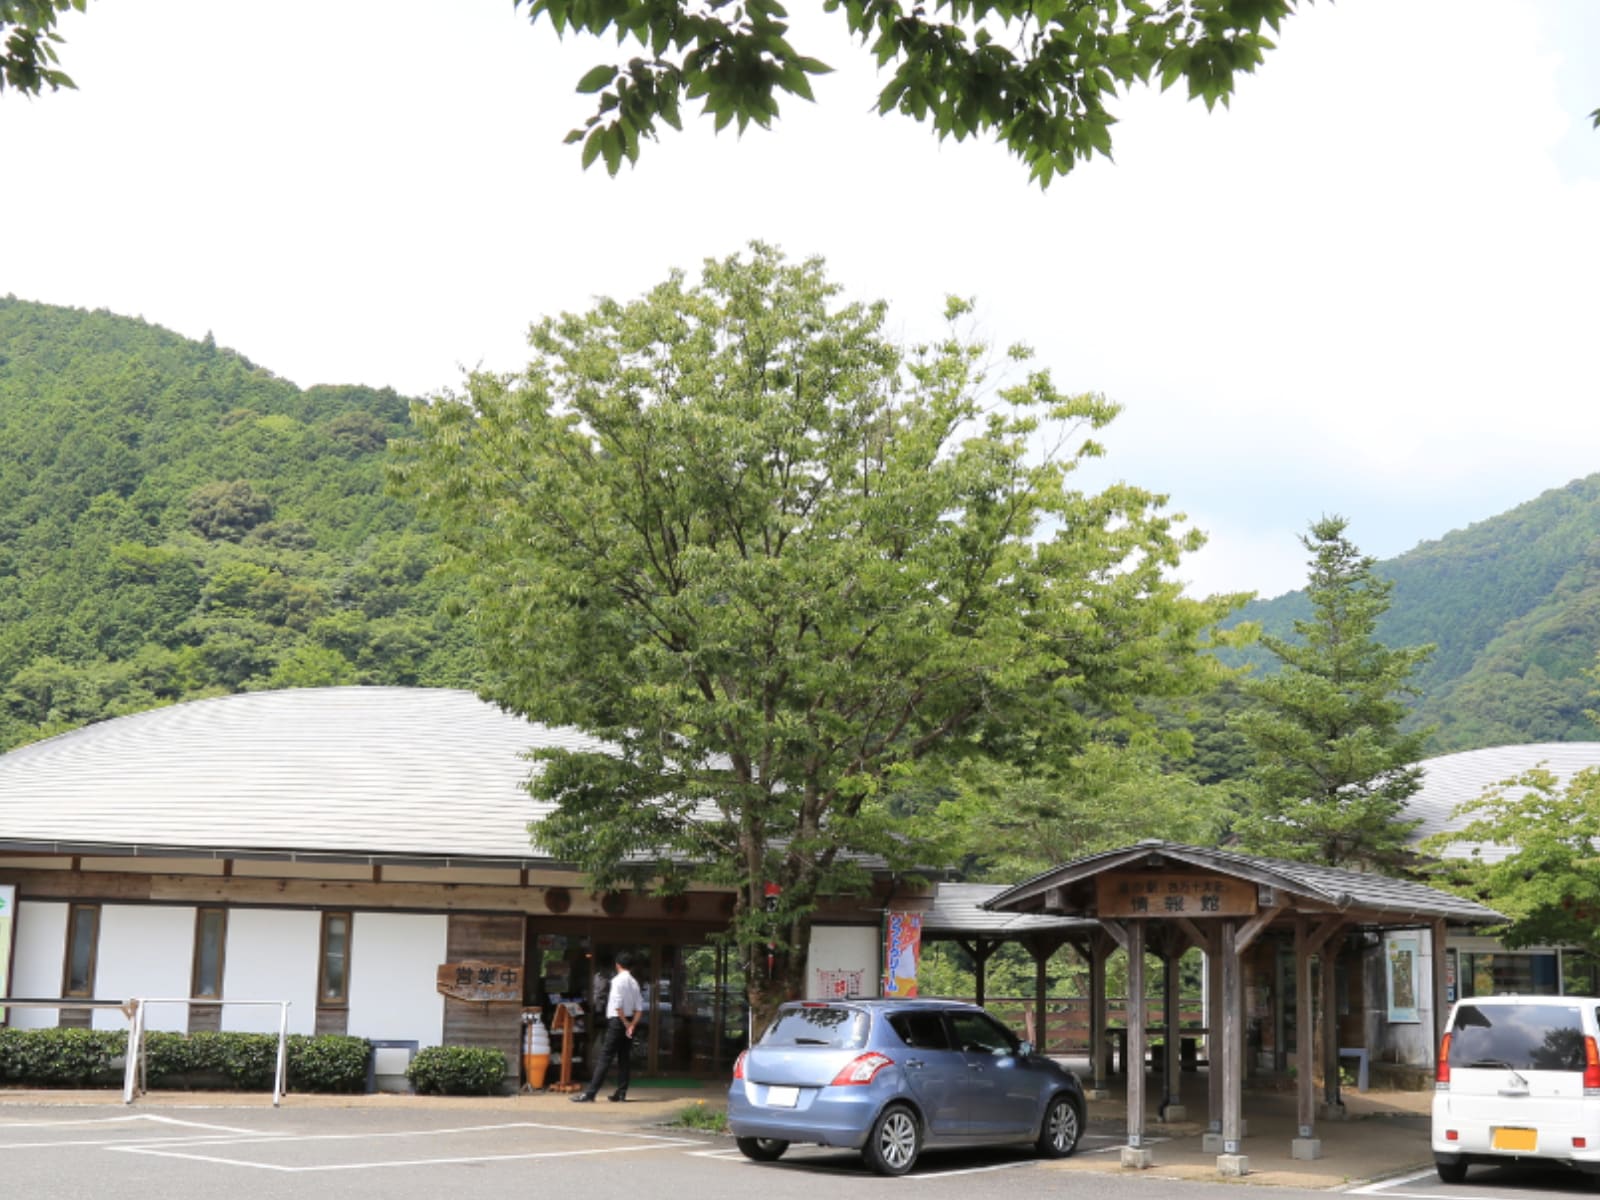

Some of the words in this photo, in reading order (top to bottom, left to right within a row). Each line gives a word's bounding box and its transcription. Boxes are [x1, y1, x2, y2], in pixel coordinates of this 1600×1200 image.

[1131, 895, 1220, 912] 情報館
[888, 916, 902, 991] ソフトクリーム
[457, 967, 517, 986] 営業中
